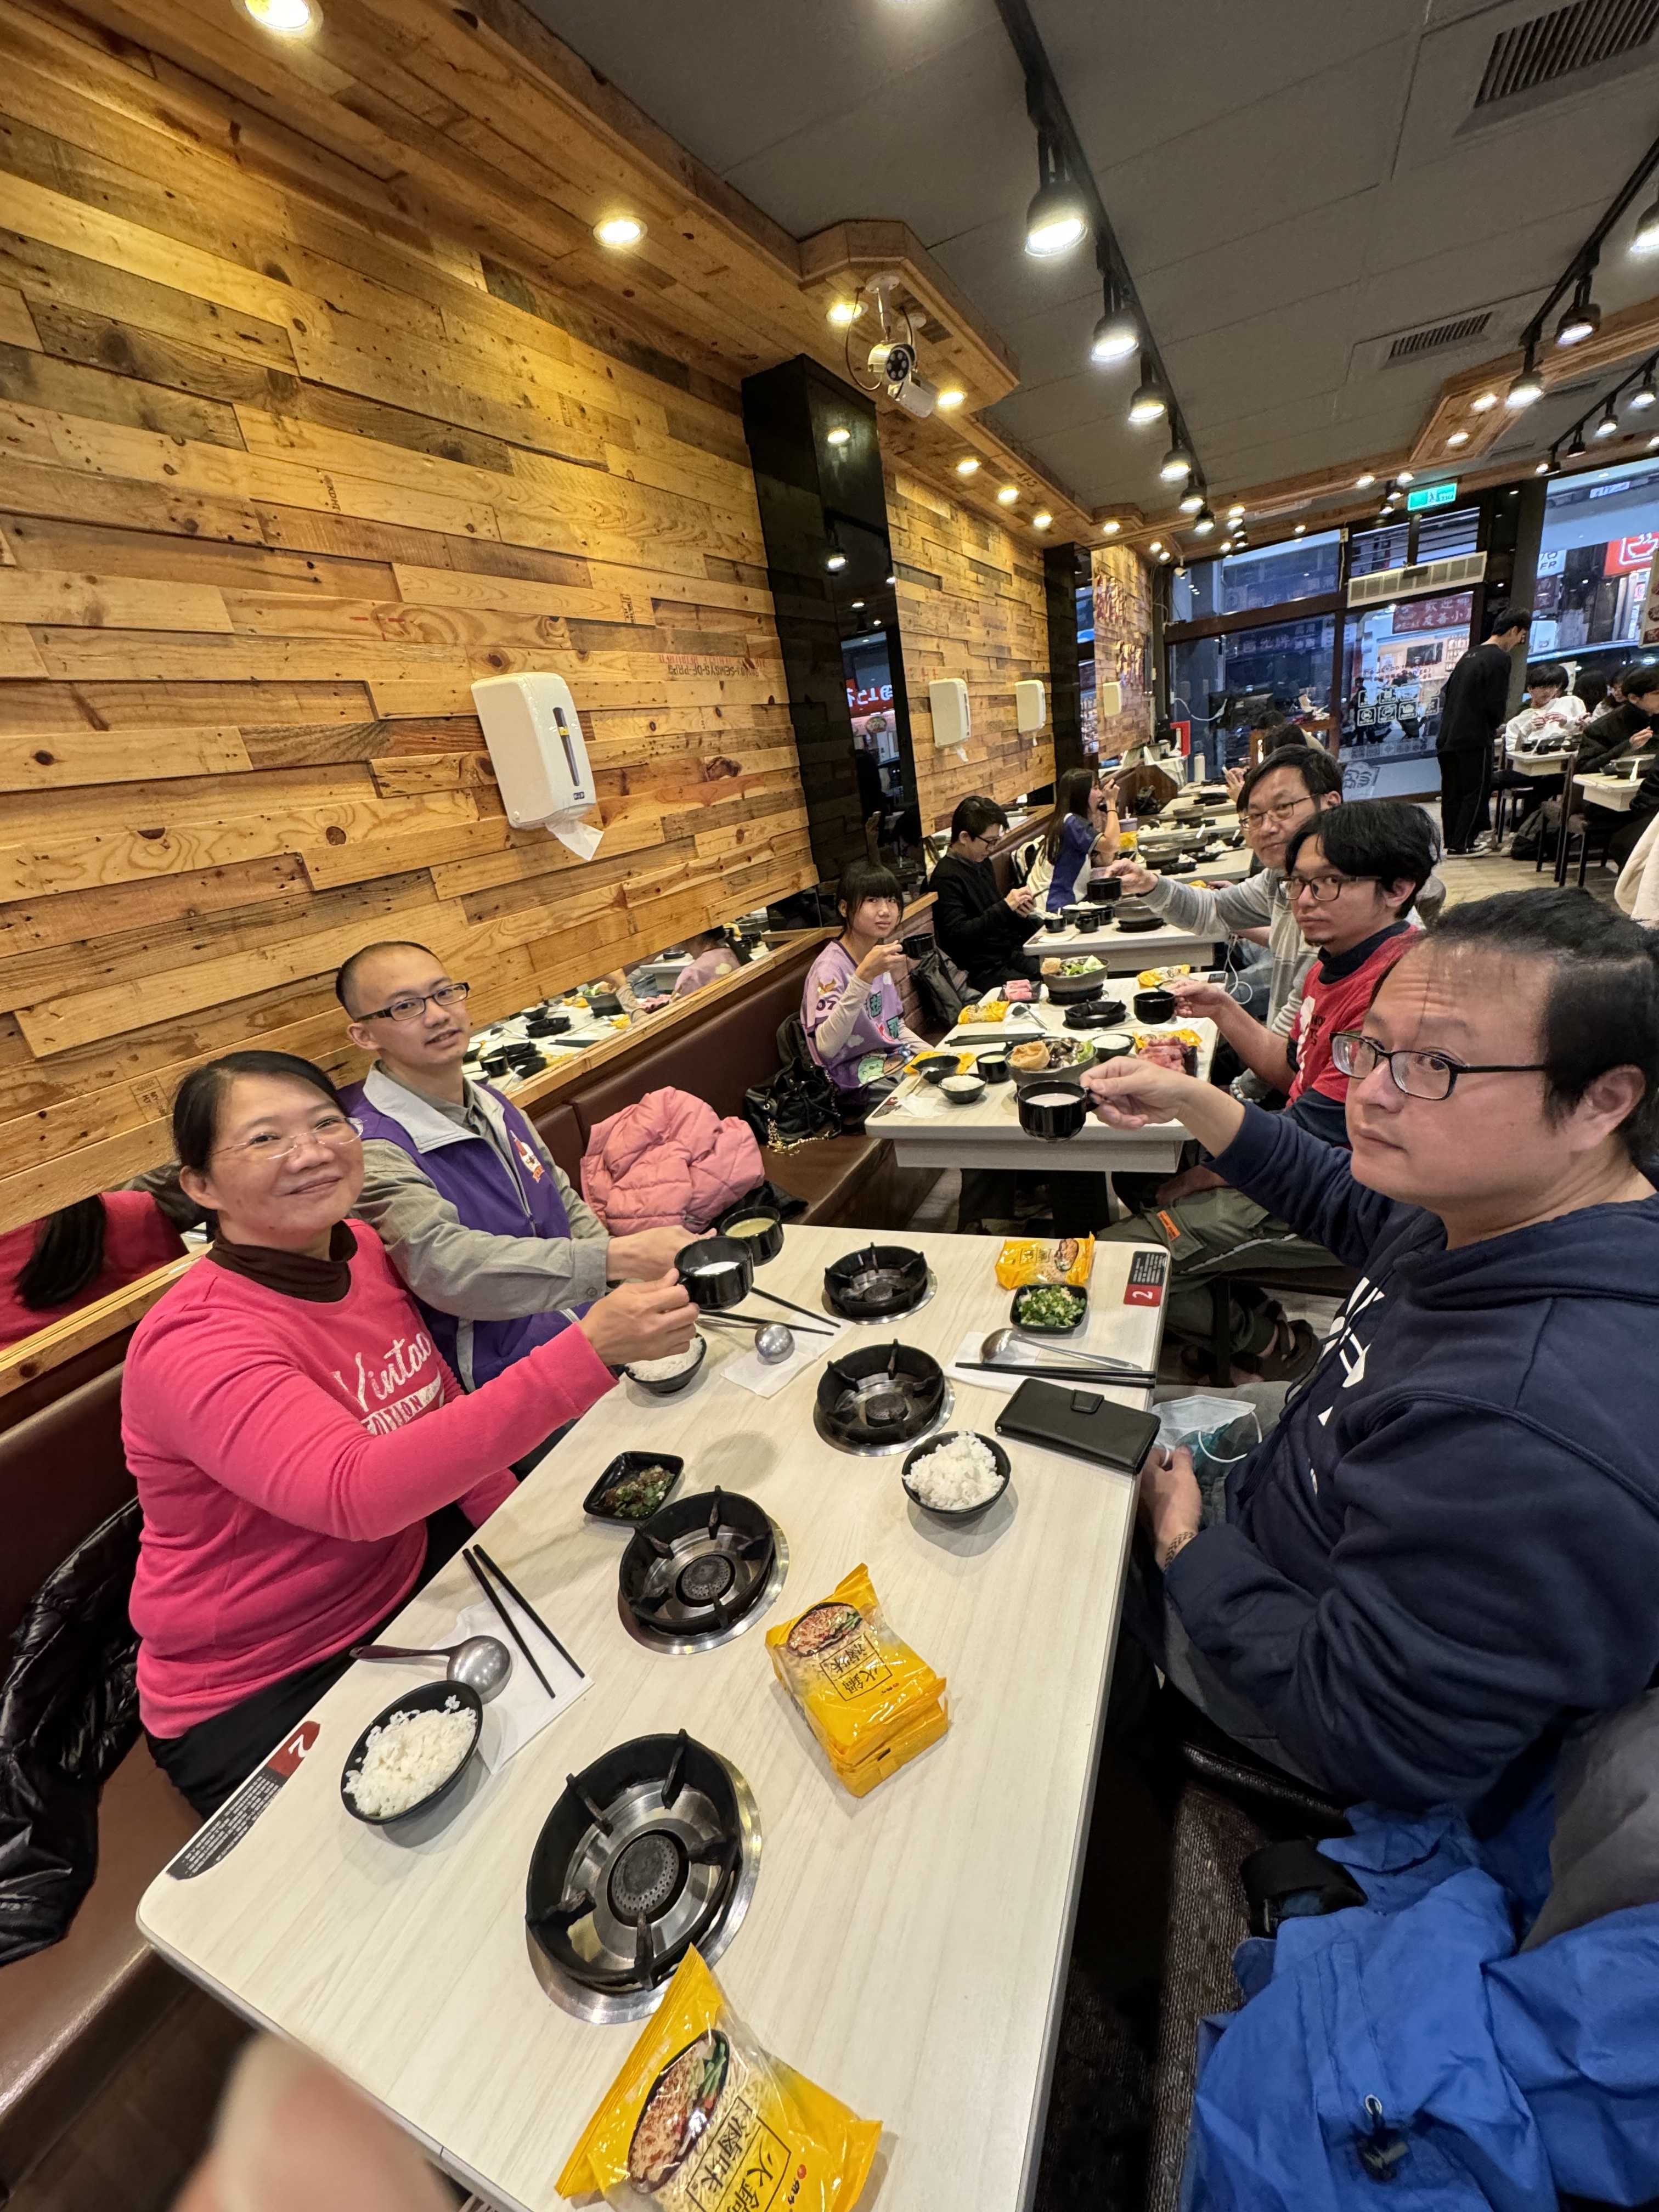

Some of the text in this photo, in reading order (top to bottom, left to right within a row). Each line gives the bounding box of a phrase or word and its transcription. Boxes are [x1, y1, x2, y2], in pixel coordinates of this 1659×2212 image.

[1132, 1290, 1153, 1300] 2
[842, 1668, 878, 1694] 火鍋
[287, 1734, 309, 1759] 2
